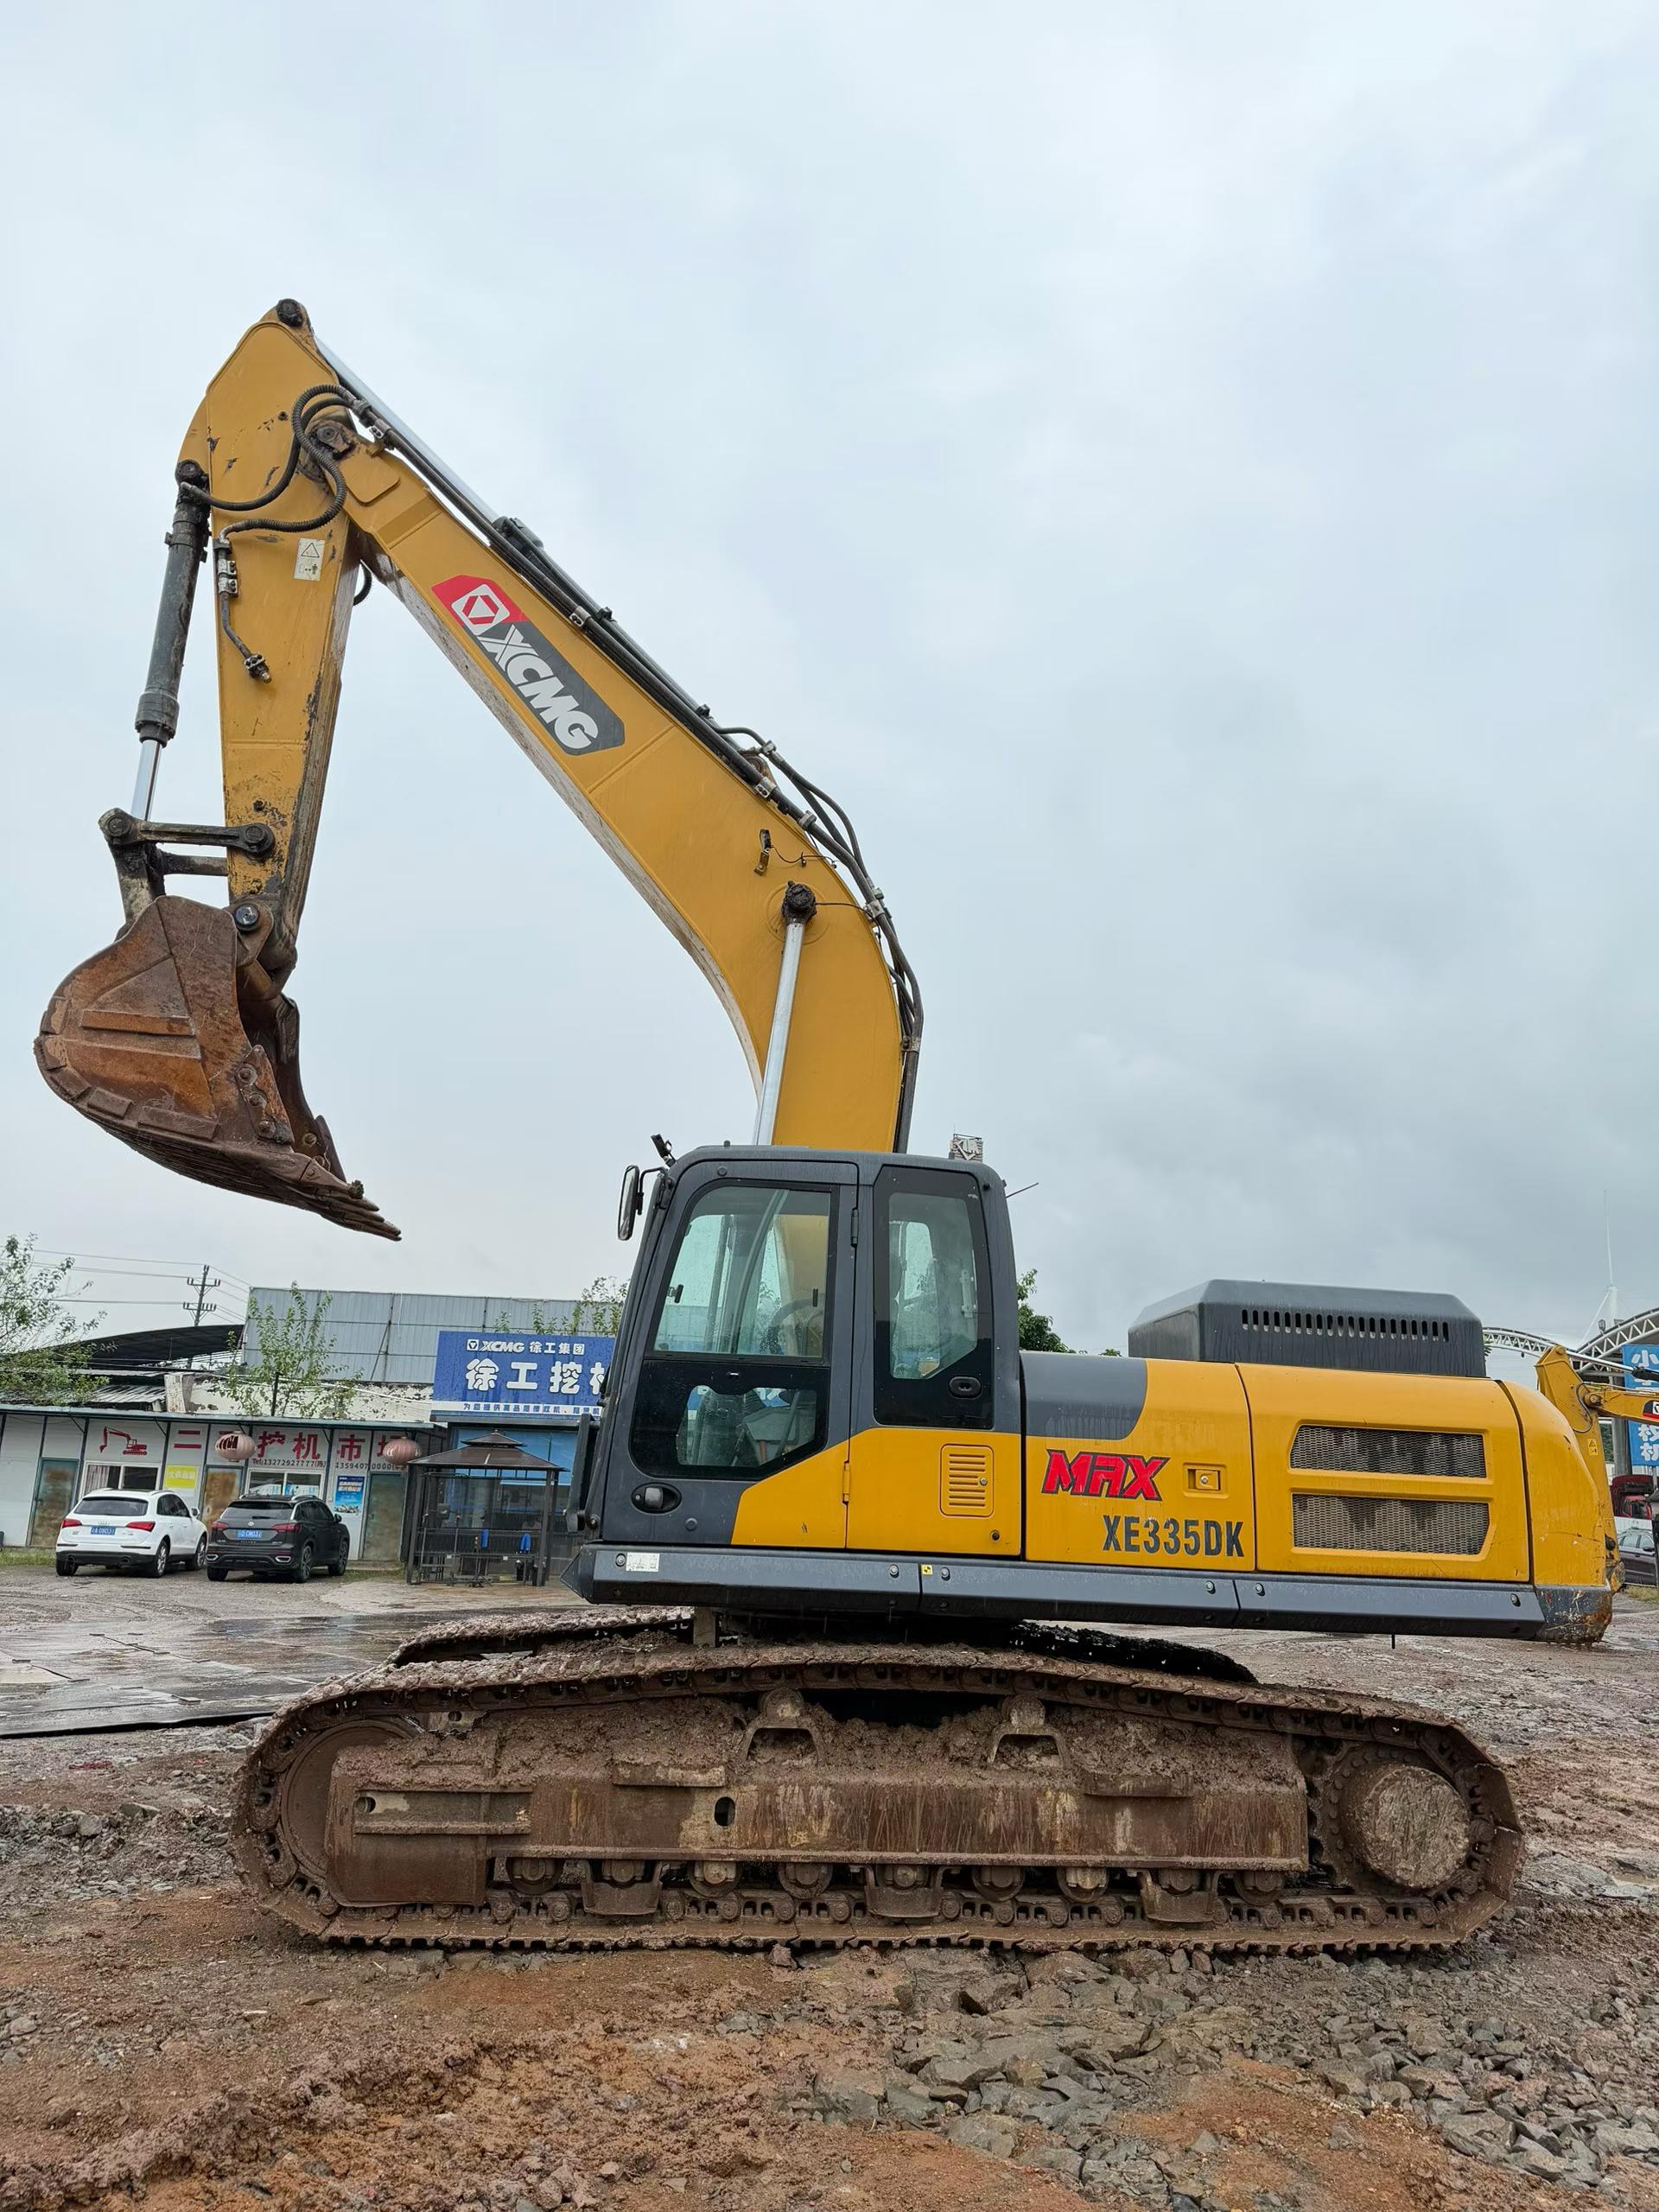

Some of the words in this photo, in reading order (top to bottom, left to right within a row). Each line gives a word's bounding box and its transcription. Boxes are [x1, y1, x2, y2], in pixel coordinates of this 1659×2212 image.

[476, 624, 599, 749] XCMG
[480, 1340, 524, 1353] XCMG
[529, 1341, 585, 1356] 徐工集团
[1041, 1449, 1171, 1501] MAX
[1103, 1515, 1245, 1557] XE335DK
